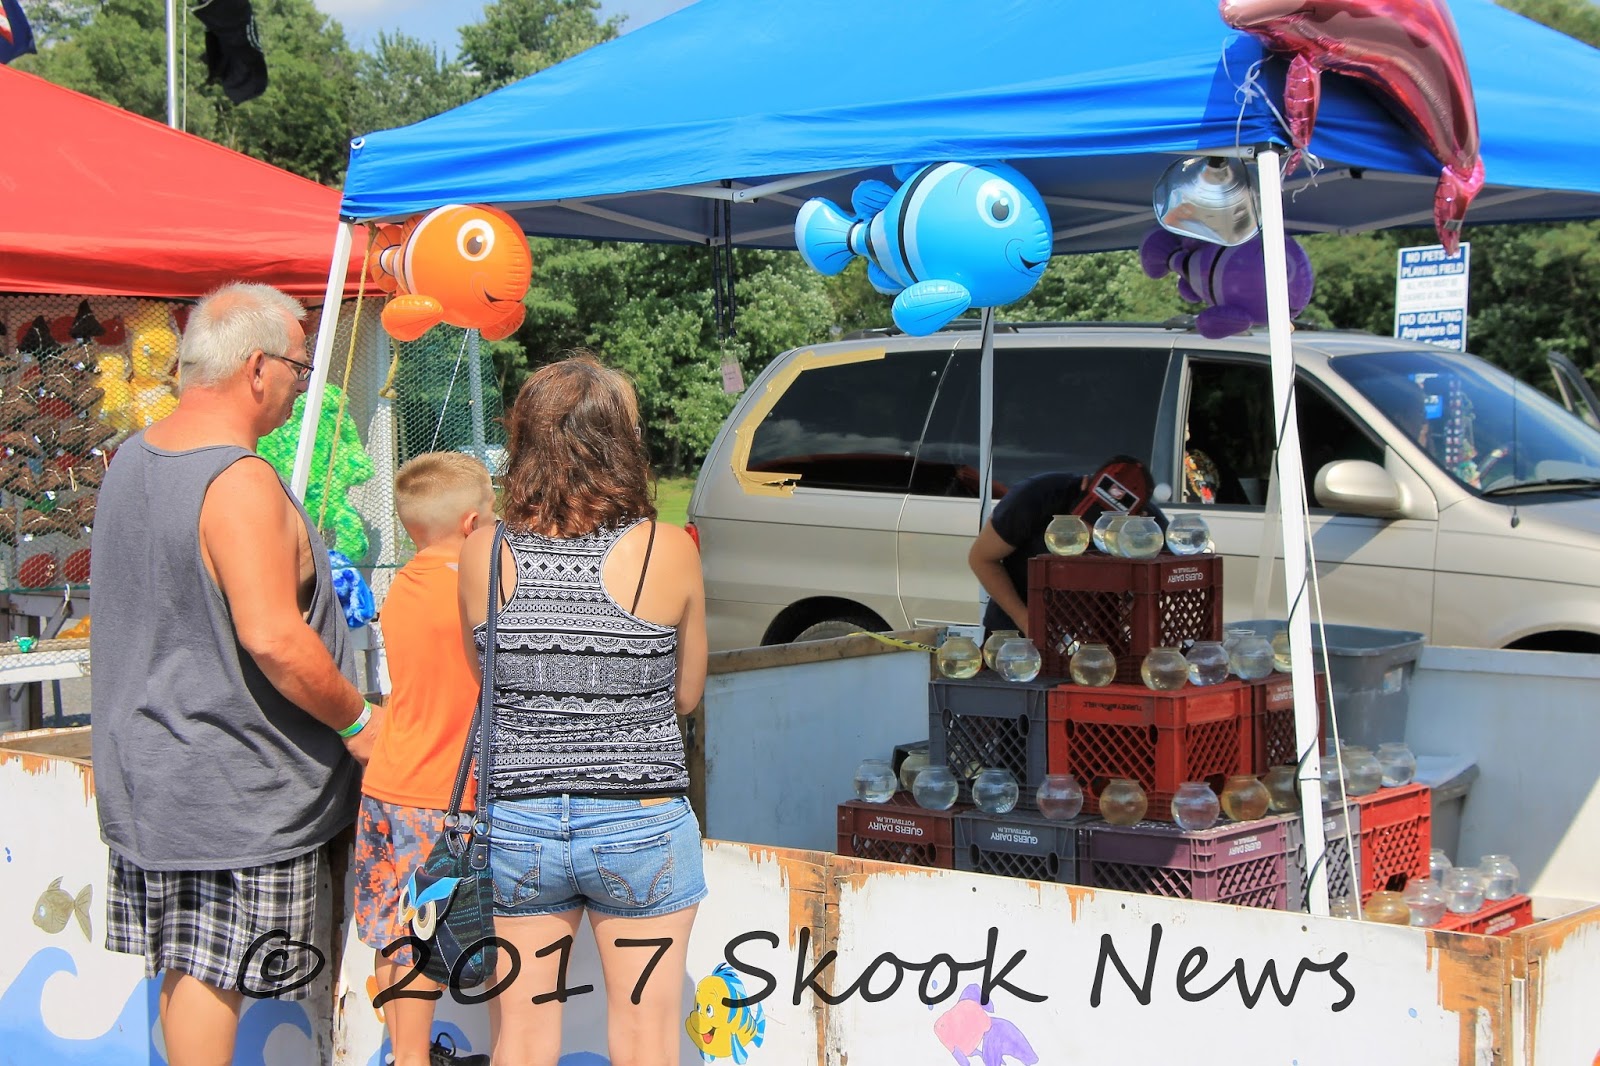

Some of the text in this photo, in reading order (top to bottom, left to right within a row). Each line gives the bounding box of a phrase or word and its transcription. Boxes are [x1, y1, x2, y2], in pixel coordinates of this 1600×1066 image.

[1406, 252, 1420, 263] NO
[1421, 249, 1445, 262] PETS
[1402, 263, 1464, 277] PLAYING FIELD
[1399, 311, 1462, 325] NO GOLFING
[1402, 322, 1460, 341] Anywhere On
[1167, 572, 1204, 583] GUERS DAIRY
[867, 821, 924, 837] GUERS DAIRY
[990, 831, 1038, 845] GUERS DAIRY
